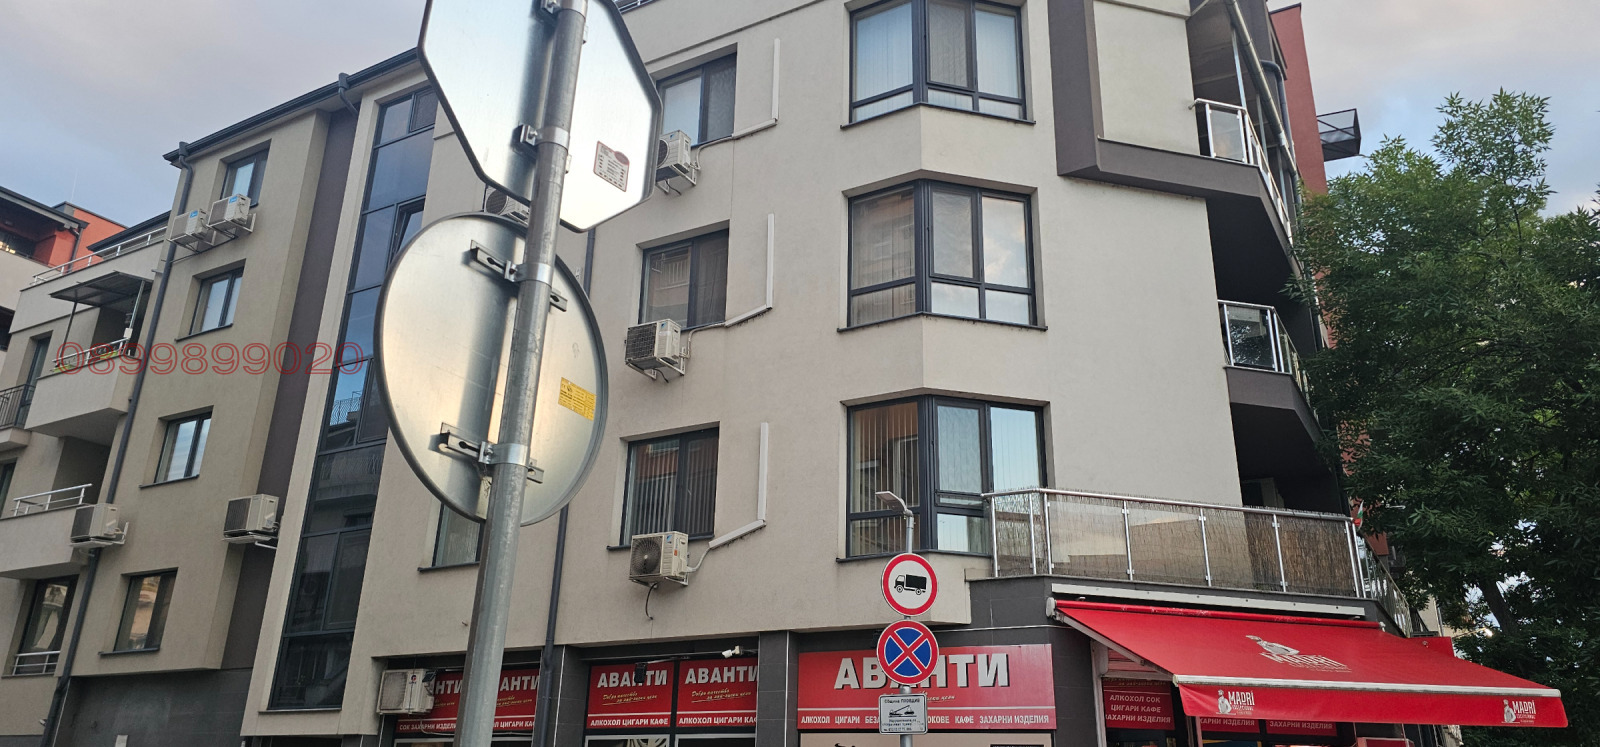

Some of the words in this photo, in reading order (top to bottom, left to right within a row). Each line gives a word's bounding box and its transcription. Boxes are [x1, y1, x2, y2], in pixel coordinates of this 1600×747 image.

[500, 675, 540, 692] АНТИ
[1109, 694, 1144, 702] АЛКОХОЛ
[1110, 704, 1139, 712] ЦИГАРИ
[622, 719, 649, 727] ЦИГАРИ
[678, 717, 712, 725] АЛКОХОЛ
[713, 716, 743, 725] ЦИГАРИ
[801, 715, 830, 724] АЛКОХОЛ
[834, 715, 860, 725] ЦИГАРИ
[927, 715, 950, 724] ОКОВЕ
[955, 714, 974, 724] КАФЕ
[979, 714, 1013, 724] ЗАХАРНИ
[1014, 714, 1049, 724] ИЗДЕЛИЯ
[1137, 716, 1171, 724] ИЗДЕЛИЯ
[1222, 719, 1255, 727] ИЗДЕЛИЯ
[436, 722, 457, 730] ИЗДЕЛИ
[499, 721, 524, 729] ЦИГАРИ
[1301, 722, 1333, 730] ИЗДЕЛИЯ
